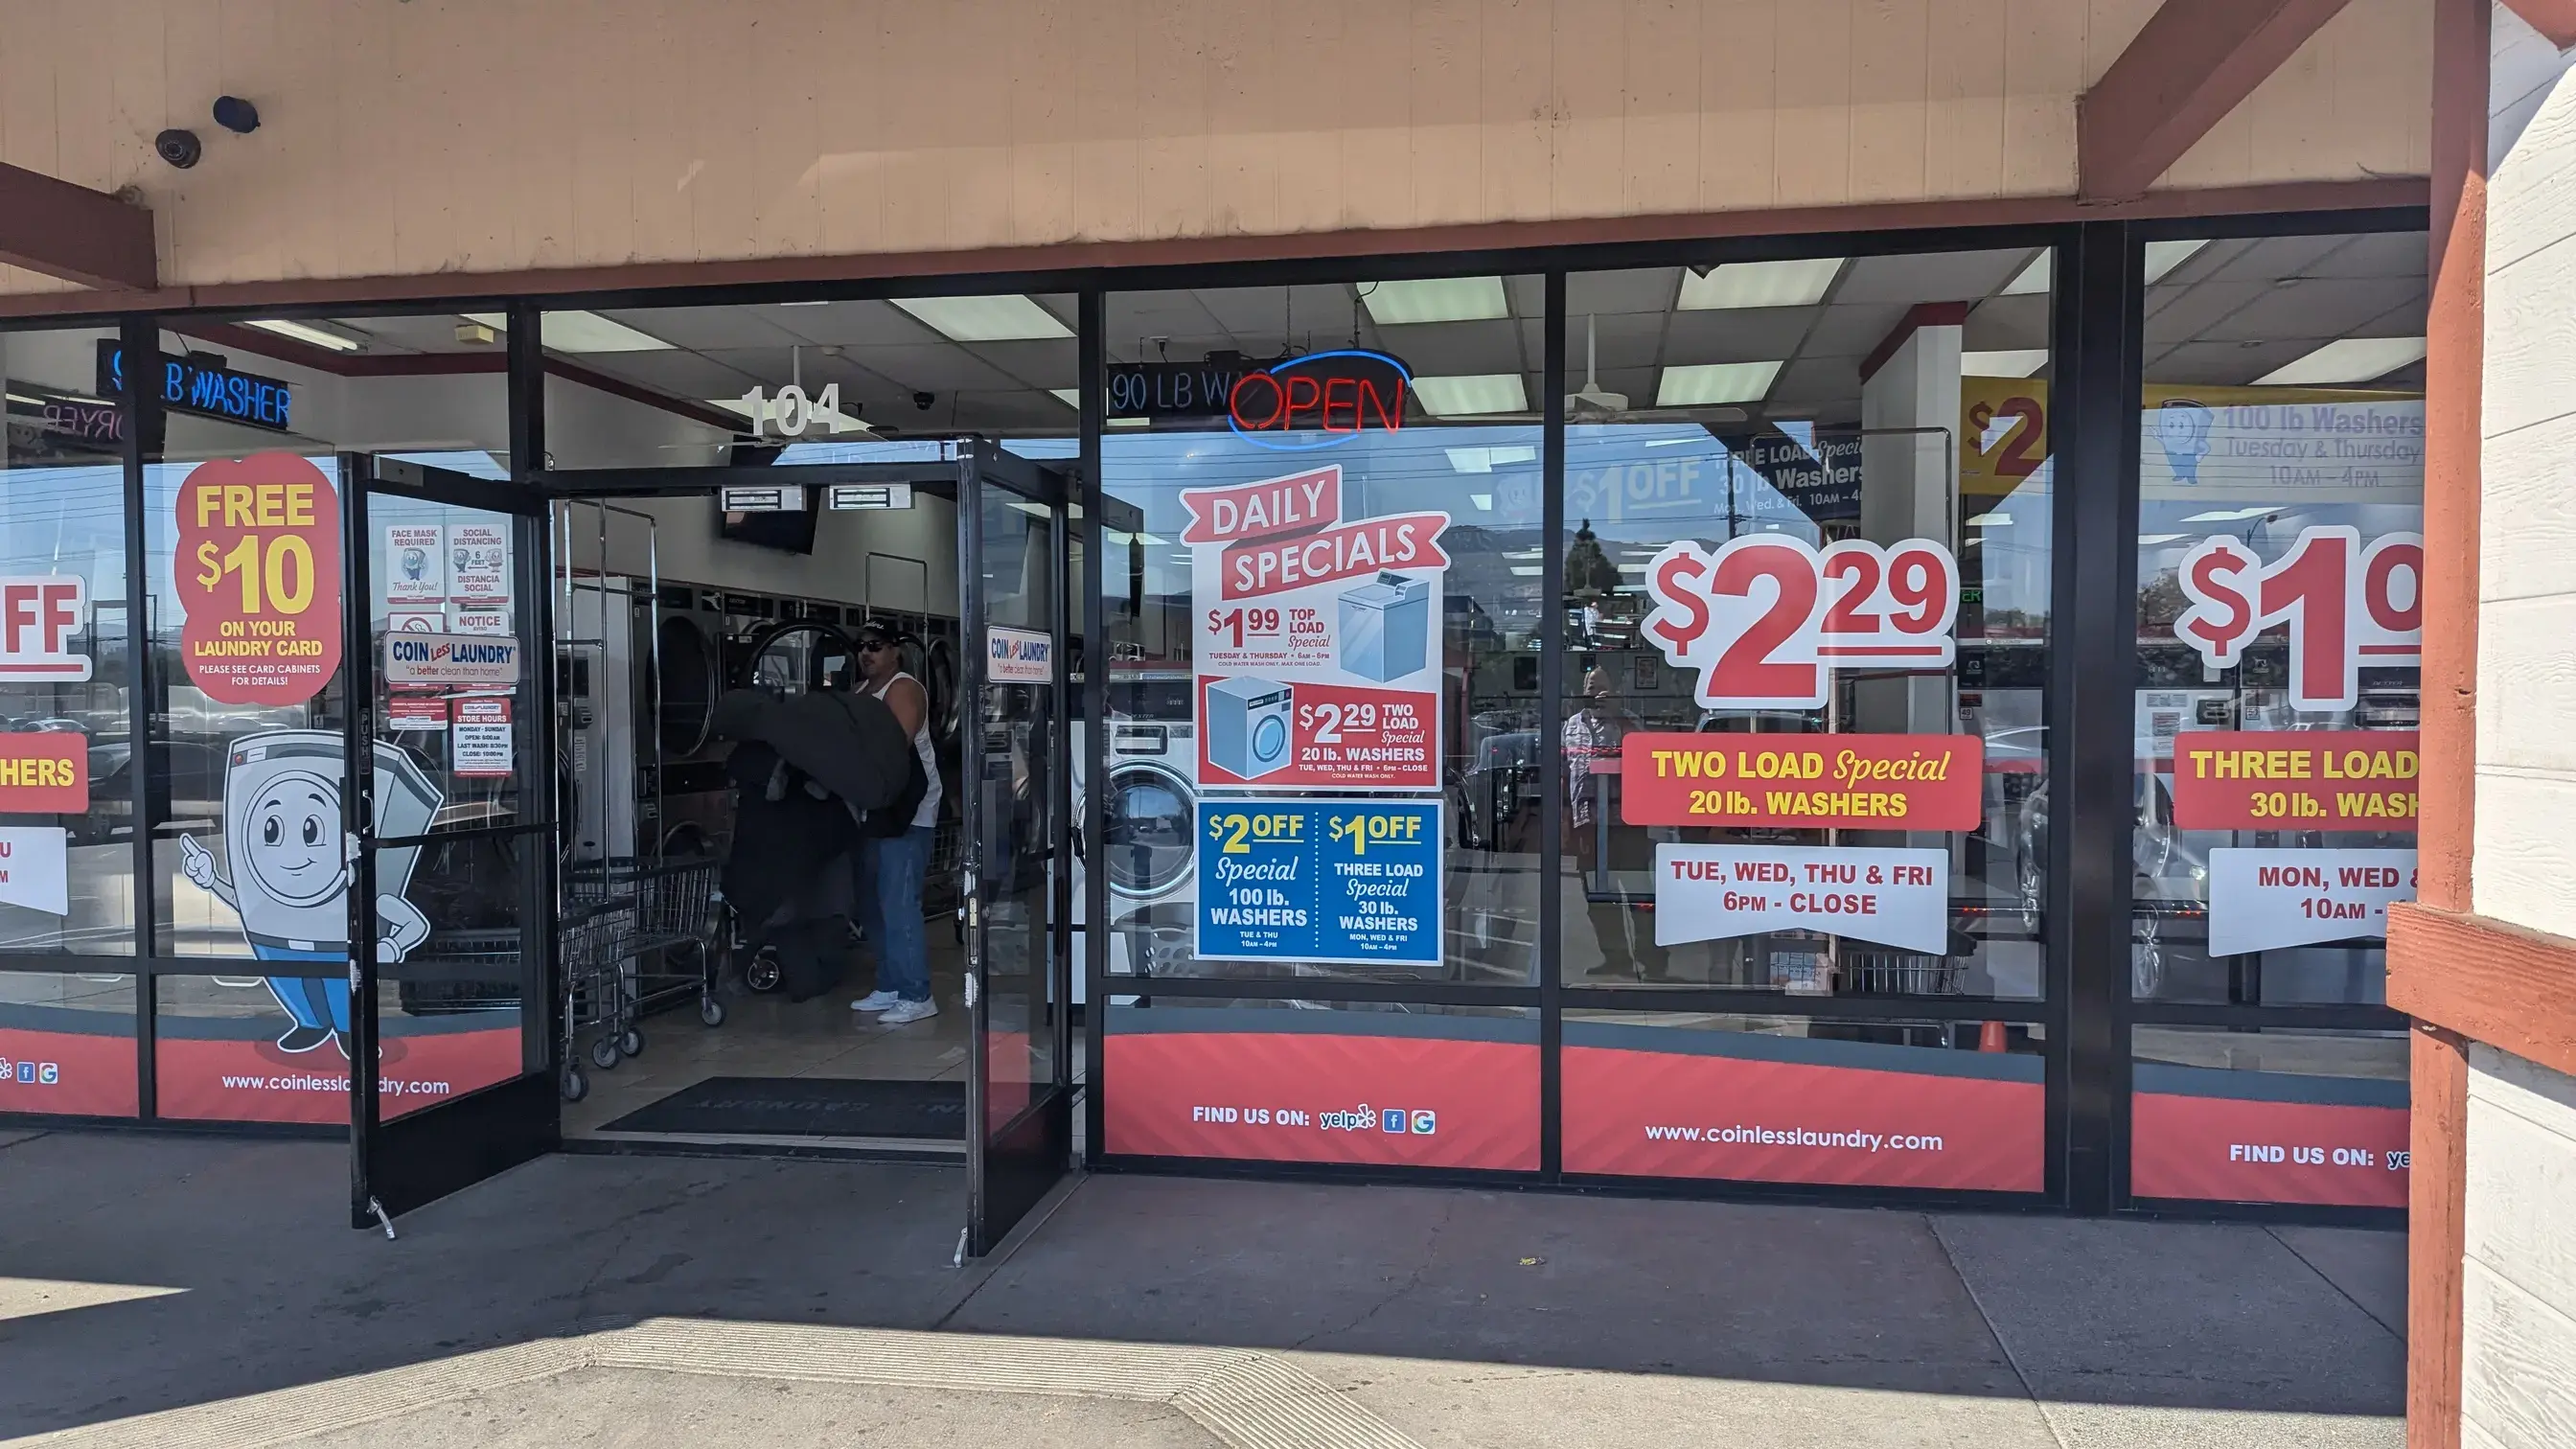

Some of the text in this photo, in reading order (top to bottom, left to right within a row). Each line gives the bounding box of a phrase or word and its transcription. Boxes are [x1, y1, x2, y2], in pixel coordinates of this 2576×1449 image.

[191, 368, 291, 424] WASHER
[1114, 374, 1146, 410] 90
[1158, 373, 1192, 408] LB
[742, 383, 840, 436] 104
[1230, 374, 1403, 434] OPEN
[2224, 405, 2424, 435] 100 lb Washers
[1770, 445, 1811, 464] LOAD
[1818, 437, 1862, 459] Speci
[2225, 437, 2421, 464] Tuesday Thursday
[1628, 456, 1701, 500] OFF
[1719, 473, 1744, 494] 30
[196, 484, 314, 527] FREE
[1213, 480, 1325, 535] DAILY
[1810, 493, 1840, 505] 10AM
[414, 529, 437, 538] MASK
[1235, 524, 1415, 592] SPECIALS
[196, 534, 314, 614] $10
[393, 582, 438, 593] Thank You!
[5, 585, 77, 653] FF
[459, 616, 500, 626] NOTICE
[1289, 609, 1316, 621] TOP
[220, 621, 295, 636] ON YOUR
[1289, 622, 1324, 633] LOAD
[196, 640, 322, 656] LAUNDRY CARD
[393, 641, 428, 661] COIN
[431, 643, 450, 661] Less
[992, 637, 1009, 659] COIN
[1288, 635, 1331, 652] Special
[199, 664, 320, 674] PLEASE SEE CARD CABINETS
[417, 666, 478, 676] better clean than
[232, 677, 288, 685] FOR DETAILS!
[1383, 704, 1414, 717] TWO
[1383, 718, 1418, 729] LOAD
[1381, 730, 1425, 747] Special
[1301, 748, 1425, 761] 20 lb. WASHERS
[2190, 750, 2419, 779] THREE LOAD
[0, 758, 75, 786] HERS
[1651, 749, 1951, 789] TWO LOAD Special
[1689, 791, 1907, 817] 20 lb. WASHERS
[2250, 792, 2419, 817] 30 lb. WAS
[1208, 814, 1304, 854] $2 OFF
[1329, 815, 1421, 855] $1 OFF
[1215, 856, 1299, 887] Special
[1334, 863, 1423, 877] THREE LOAD
[1670, 861, 1933, 887] TUE, WED, THU FRI
[2259, 867, 2330, 891] MON,
[2338, 867, 2400, 887] WED
[1229, 888, 1290, 906] 100 lb.
[1346, 879, 1410, 901] Special
[1358, 901, 1398, 914] 30 lb.
[1723, 891, 1877, 915] 6PM CLOSE
[2301, 898, 2365, 919] 10AM
[1210, 908, 1307, 927] WASHERS
[1339, 916, 1417, 932] WASHERS
[222, 1074, 449, 1096] www.coinlessladry.com
[1193, 1107, 1358, 1131] FIND US ON: yelp
[1644, 1124, 1944, 1153] www.coinlesslaundry.com
[2230, 1144, 2374, 1166] FIND US ON:
